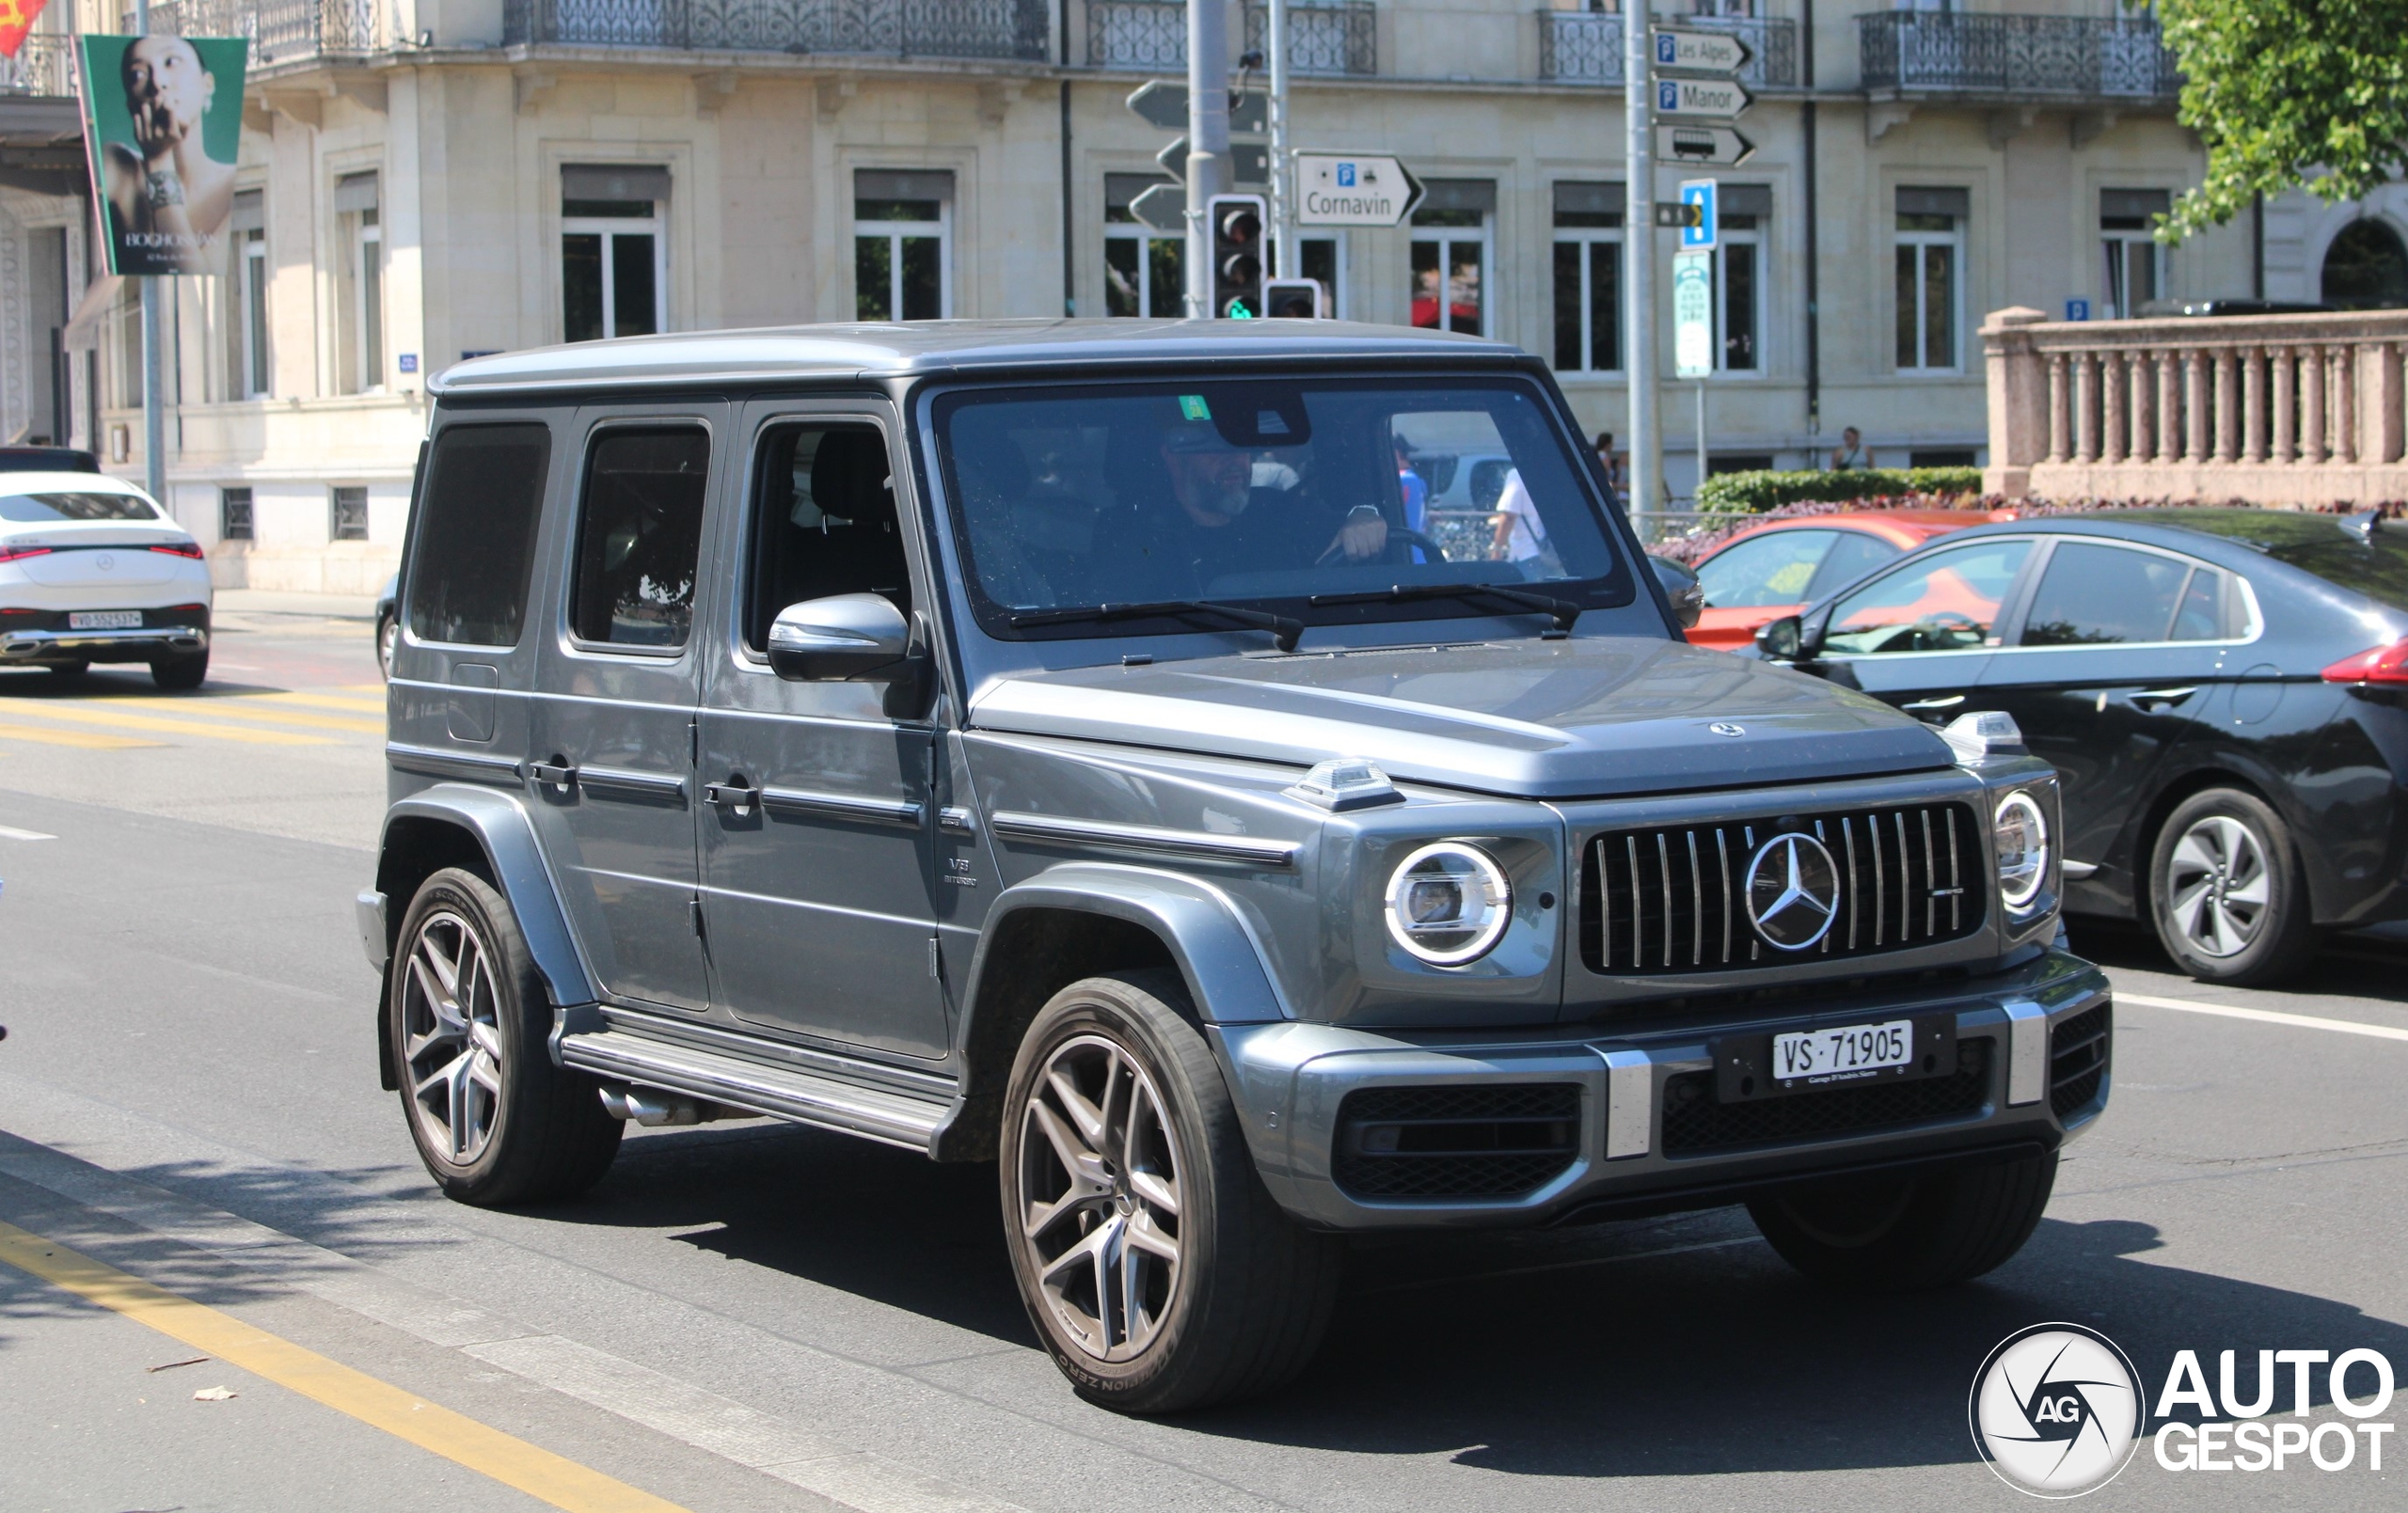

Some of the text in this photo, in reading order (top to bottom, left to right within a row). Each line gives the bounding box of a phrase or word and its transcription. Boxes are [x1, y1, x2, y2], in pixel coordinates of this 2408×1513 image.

[1677, 40, 1695, 57] Les
[1700, 41, 1732, 65] Alpes
[1684, 86, 1733, 108] Manor
[1307, 191, 1391, 215] Cornavin
[949, 858, 969, 872] V8
[1059, 1355, 1099, 1388] ZERO
